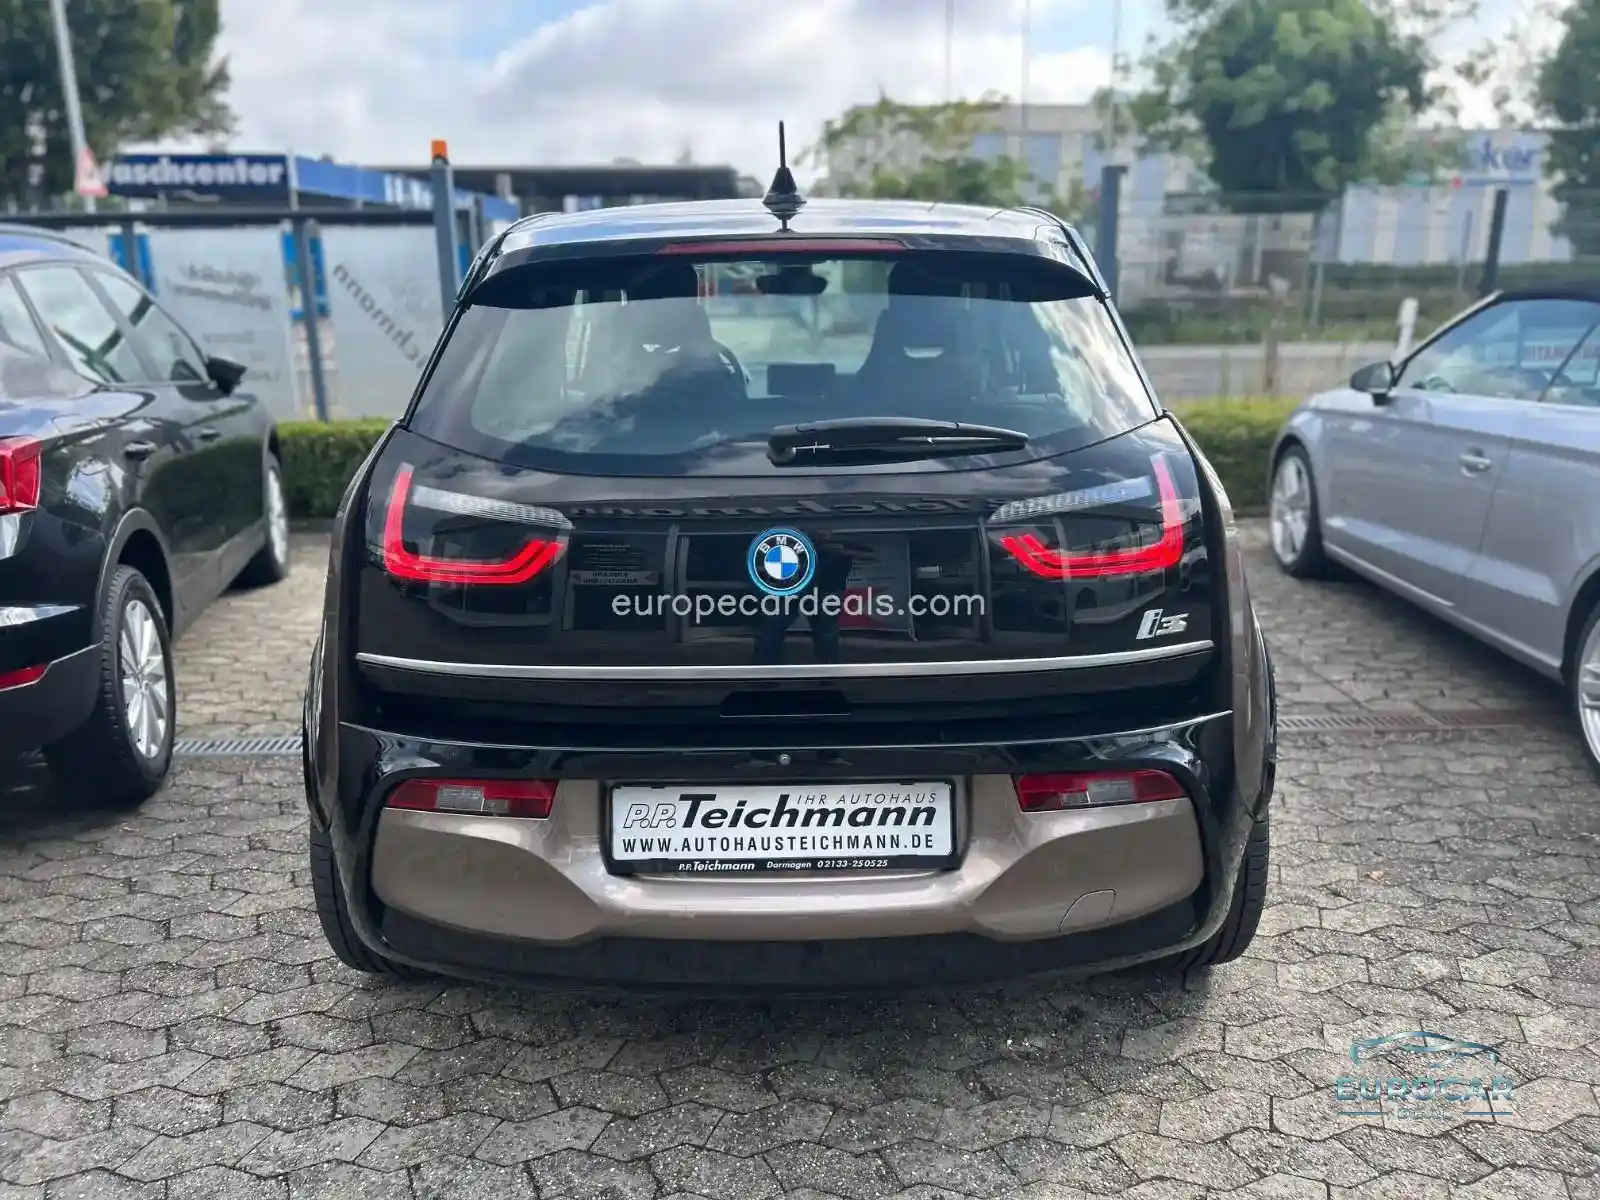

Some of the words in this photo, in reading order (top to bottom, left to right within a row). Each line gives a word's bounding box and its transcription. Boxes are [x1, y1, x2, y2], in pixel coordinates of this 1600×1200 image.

[759, 536, 805, 555] BMW
[797, 794, 826, 805] IHR
[836, 792, 937, 804] AUTOHAUS
[622, 833, 934, 853] WWW.AUTOHAUSTEICHMANN.DE
[766, 861, 812, 870] Dormagen
[817, 859, 888, 868] 02133-250525
